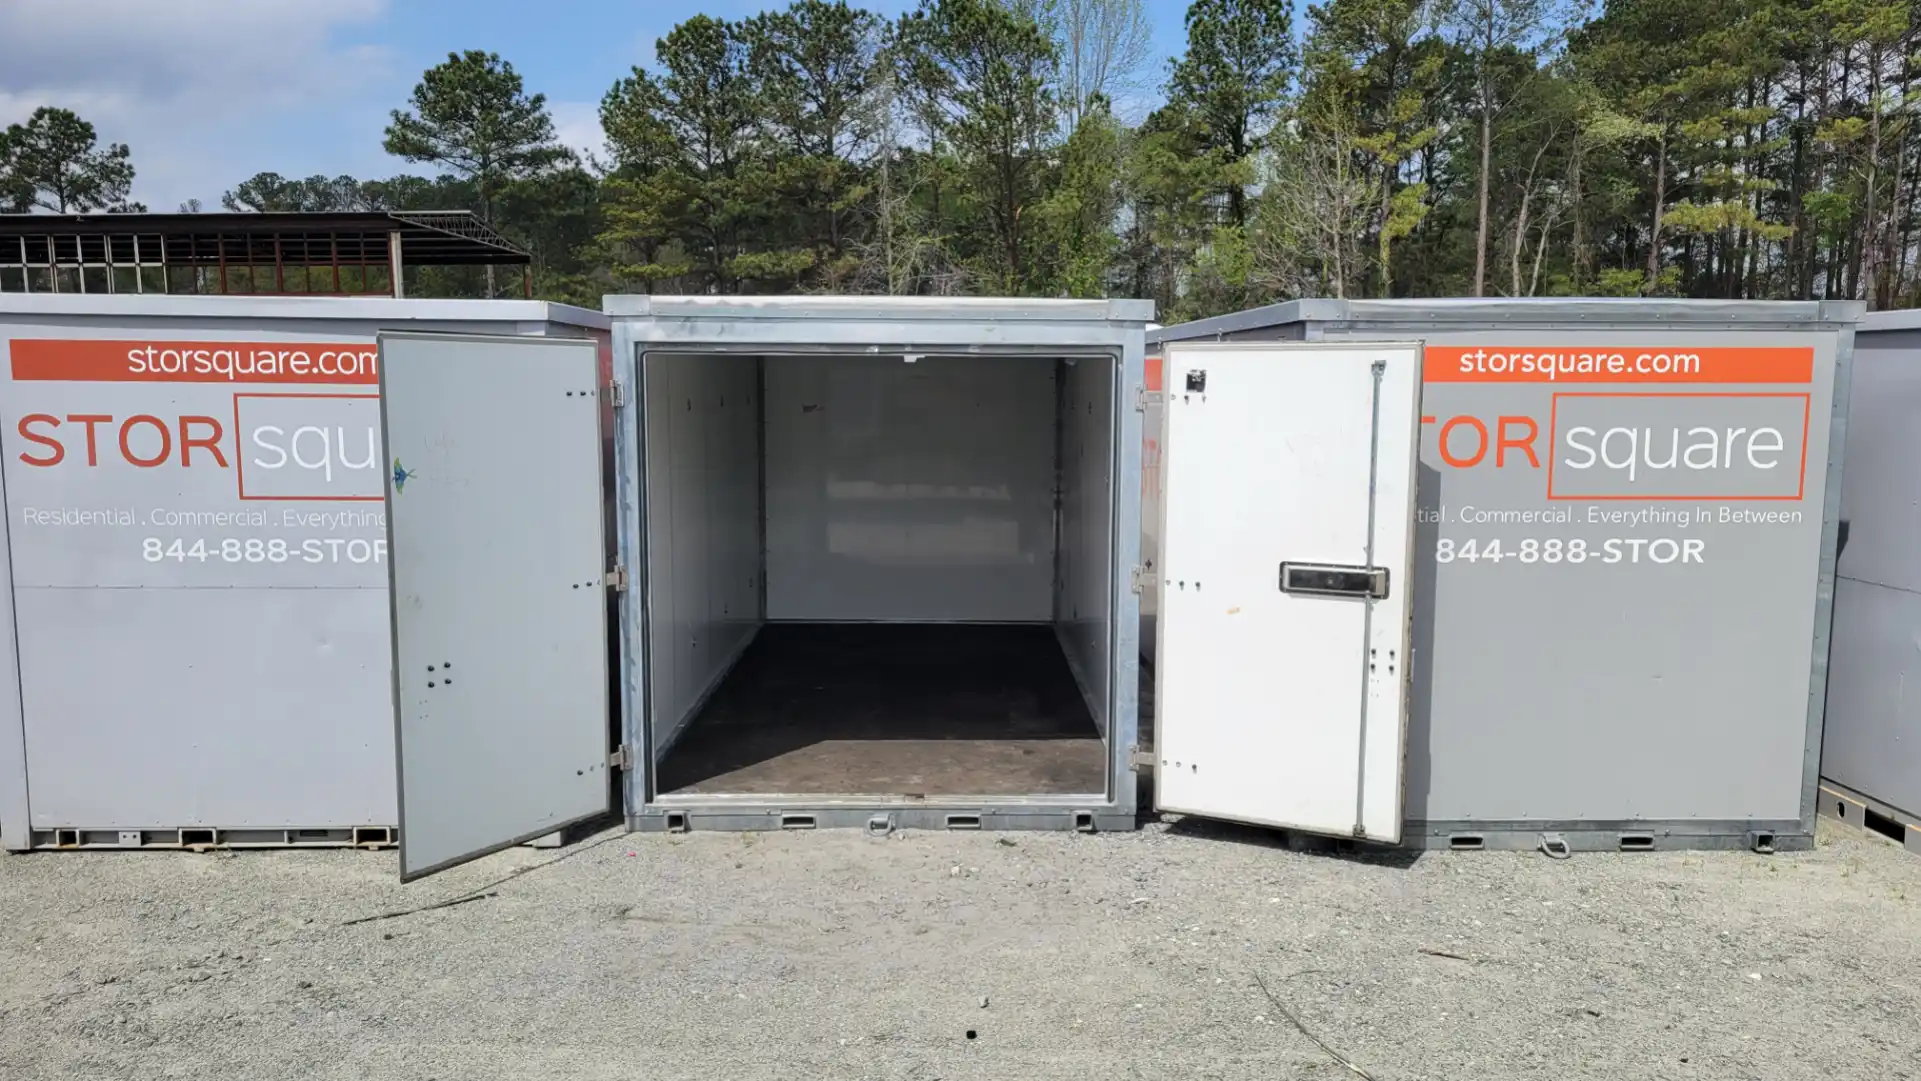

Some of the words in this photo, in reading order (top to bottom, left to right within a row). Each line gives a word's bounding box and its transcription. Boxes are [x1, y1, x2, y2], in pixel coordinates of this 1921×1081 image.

[127, 345, 378, 380] storsquare.com
[1459, 349, 1700, 380] storsquare.com
[17, 413, 229, 468] STOR
[252, 425, 376, 483] squ
[1421, 414, 1541, 469] OR
[1564, 426, 1784, 482] square
[22, 506, 136, 526] Residential
[150, 508, 267, 527] Commercial
[1459, 505, 1572, 524] Commercial
[1587, 505, 1690, 529] Everything
[1695, 506, 1712, 524] In
[1718, 506, 1802, 525] Between
[1435, 538, 1705, 564] 844-888-STOR
